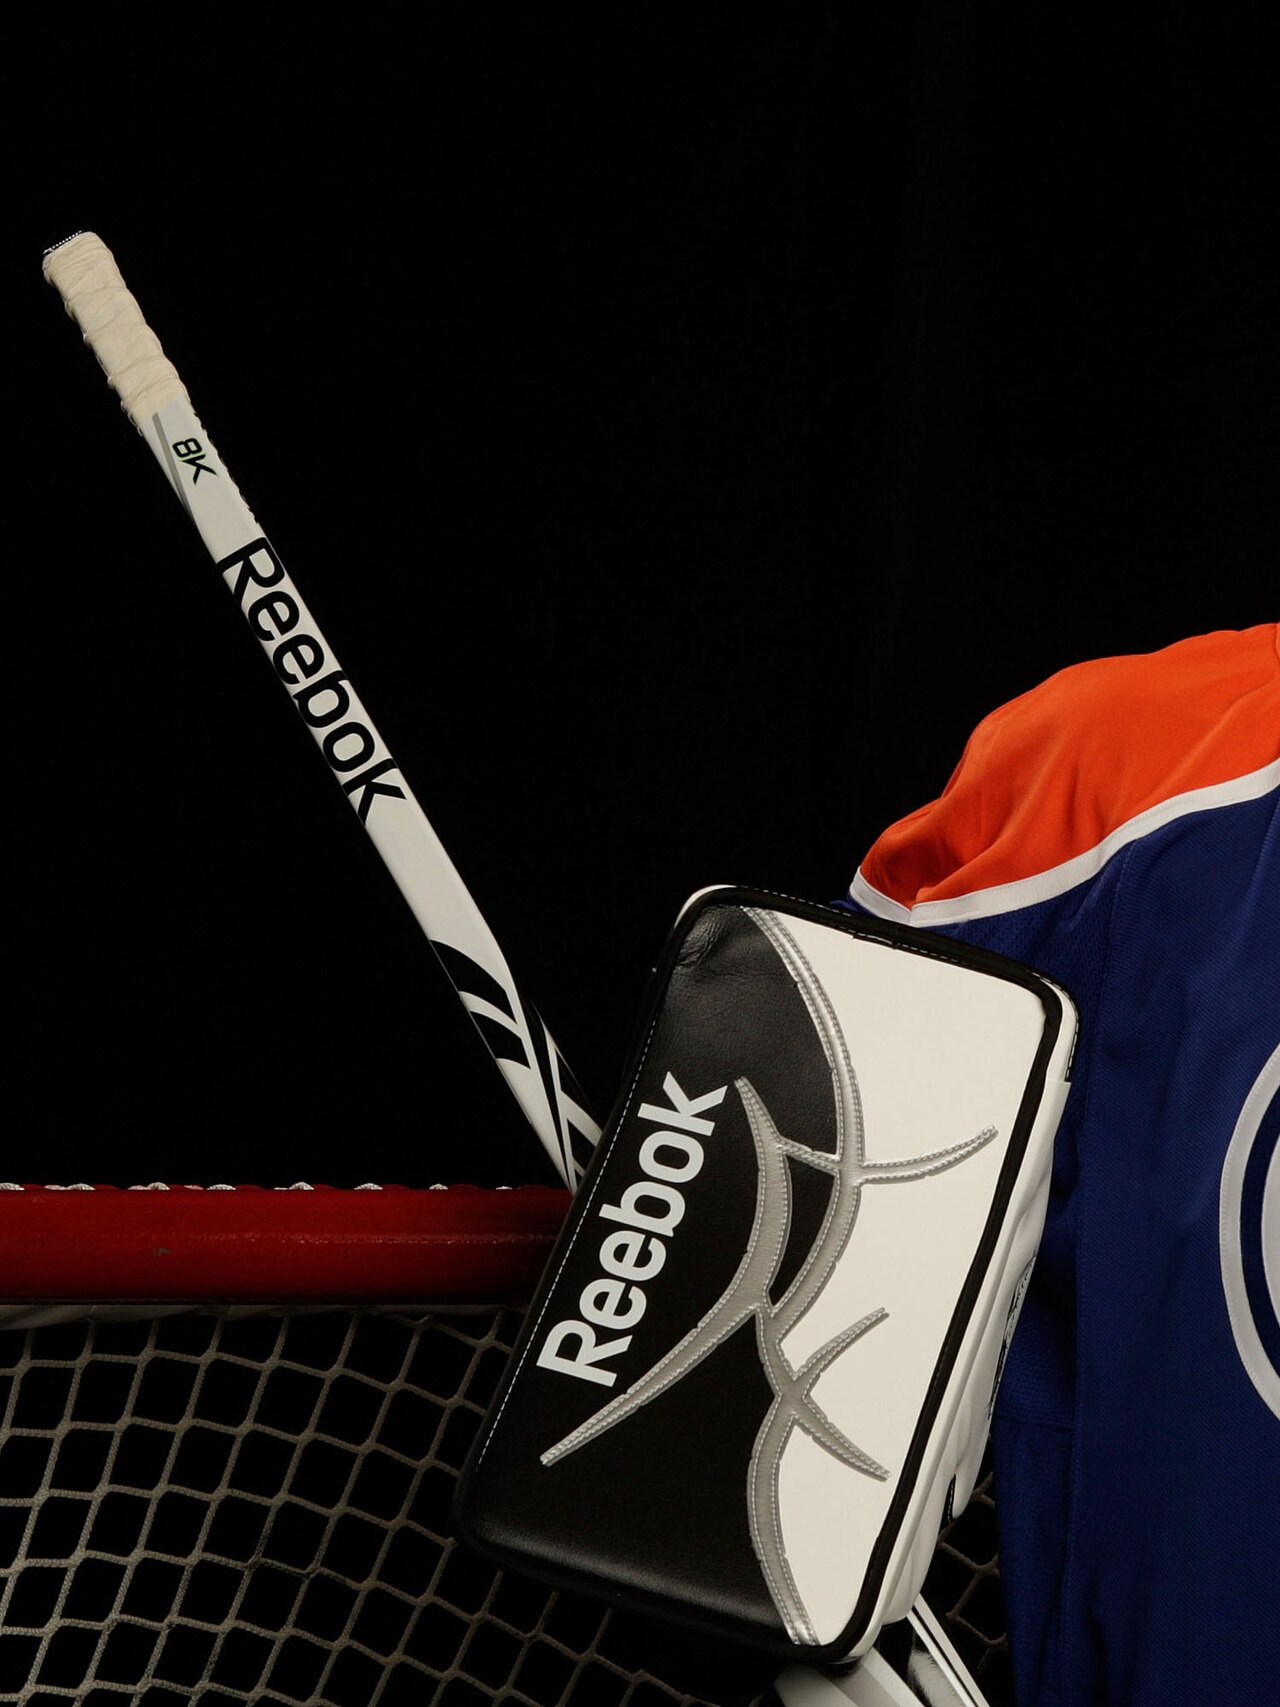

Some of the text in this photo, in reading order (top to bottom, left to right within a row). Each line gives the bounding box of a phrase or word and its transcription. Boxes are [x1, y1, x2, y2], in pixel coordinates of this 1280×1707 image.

[172, 437, 218, 485] 8K
[215, 536, 407, 826] Reebok
[536, 1071, 728, 1387] Reebok
